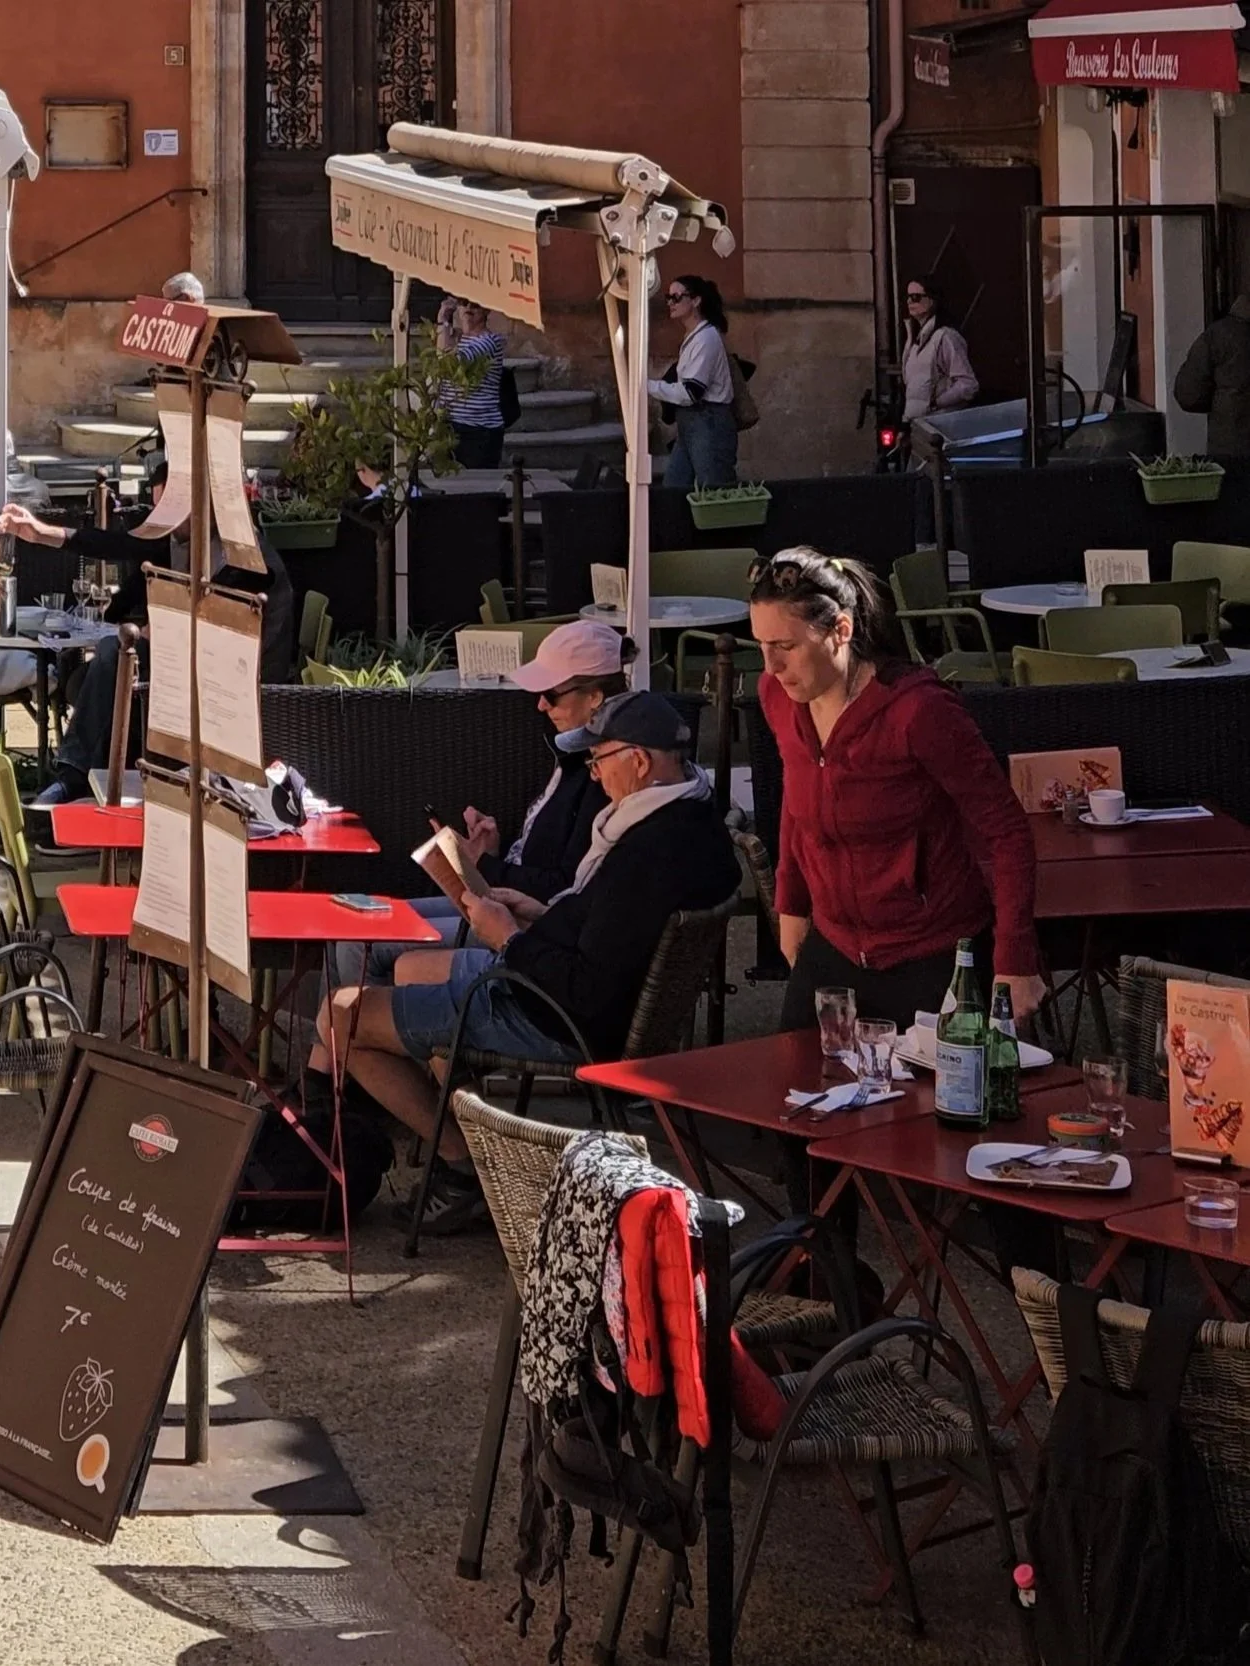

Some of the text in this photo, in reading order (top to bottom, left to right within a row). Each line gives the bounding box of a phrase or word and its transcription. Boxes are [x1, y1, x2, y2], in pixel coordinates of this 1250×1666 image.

[171, 50, 178, 61] 5
[1065, 38, 1179, 81] Brasserie Les Couleurs
[123, 313, 197, 358] CASTRUM
[1174, 1003, 1187, 1016] Le
[68, 1168, 181, 1238] Coupe de fraises
[52, 1244, 88, 1279] Crème
[60, 1305, 92, 1334] 7€
